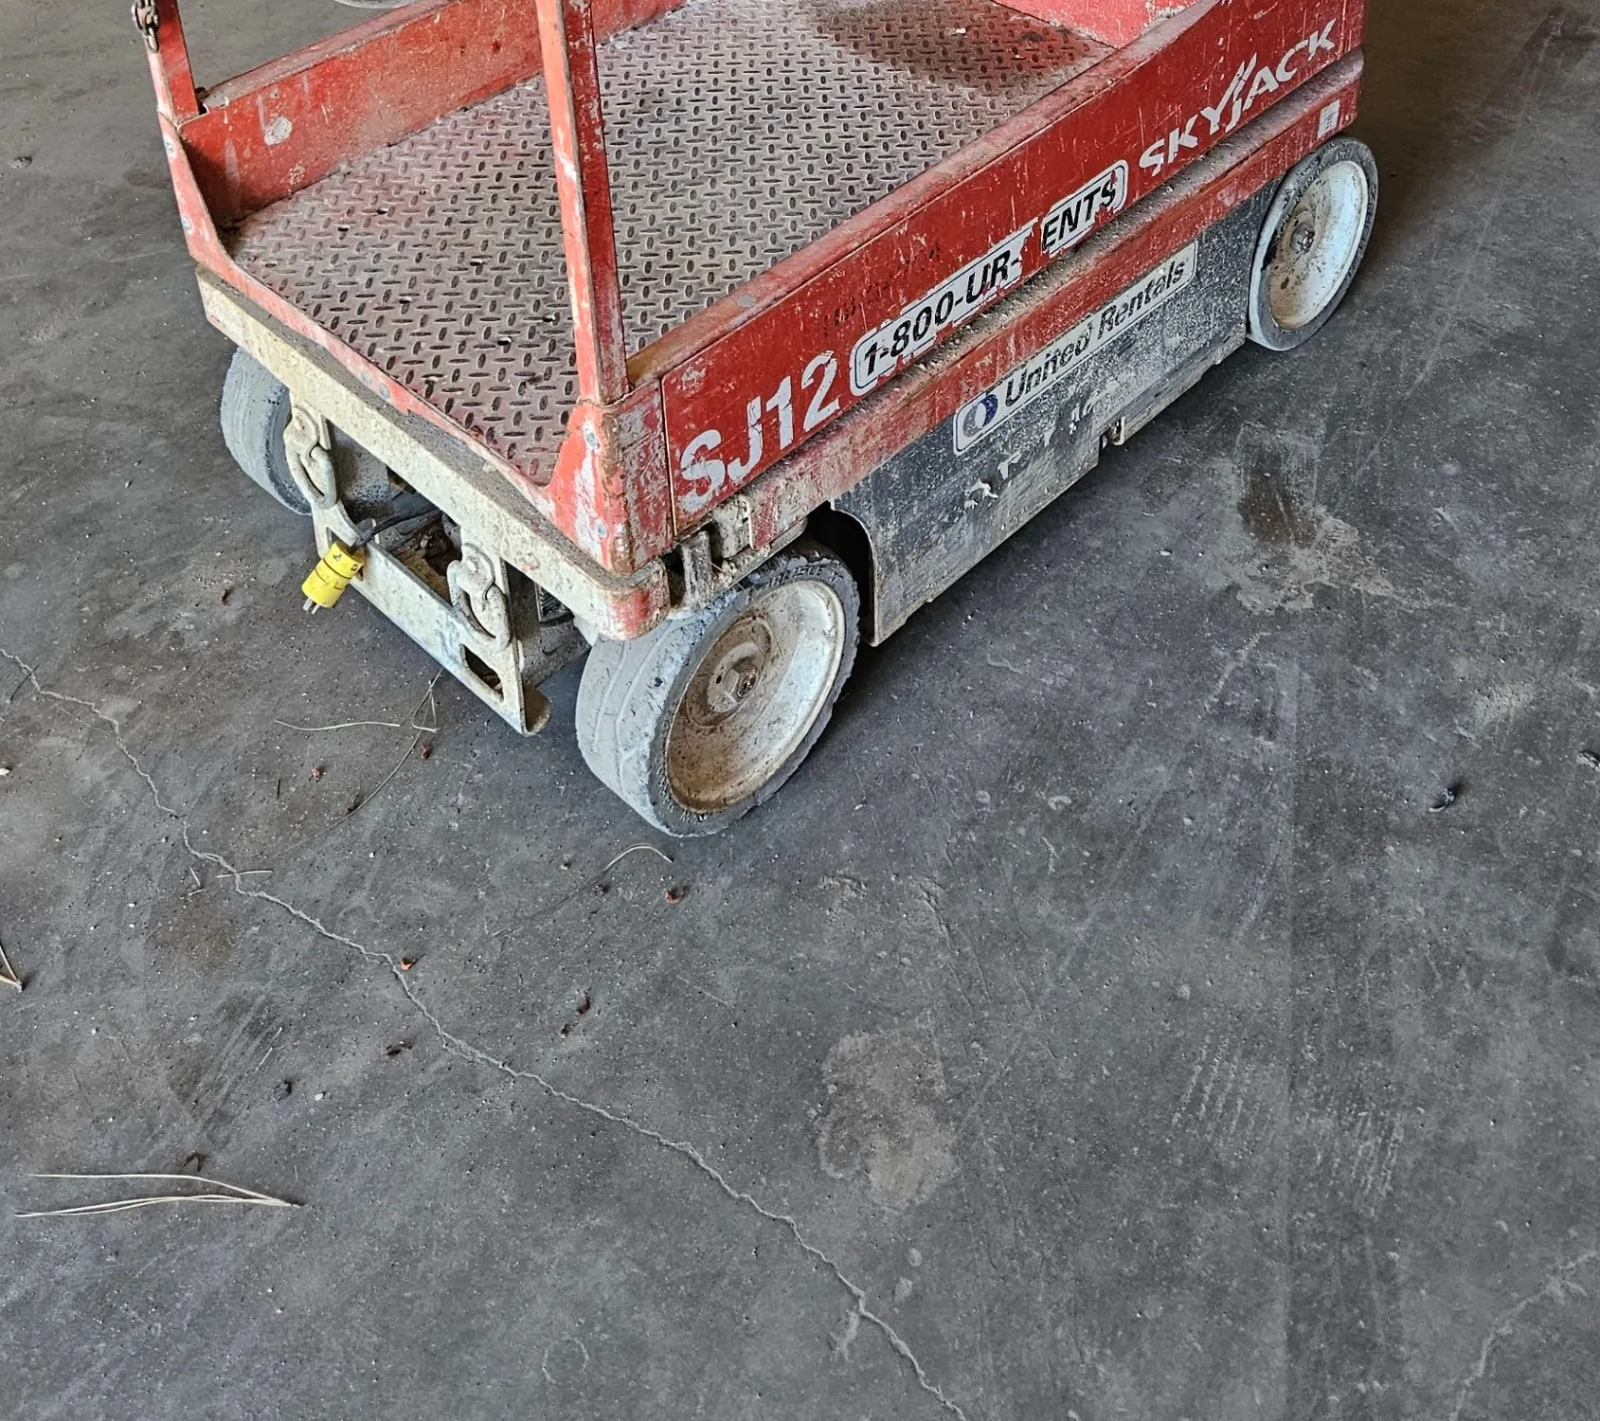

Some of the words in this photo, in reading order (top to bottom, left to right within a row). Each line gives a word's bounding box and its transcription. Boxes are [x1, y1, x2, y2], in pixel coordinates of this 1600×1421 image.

[1139, 19, 1336, 176] SKYJACK
[1004, 322, 1094, 407] United
[1098, 260, 1186, 340] Rentals
[680, 350, 841, 512] SJ12
